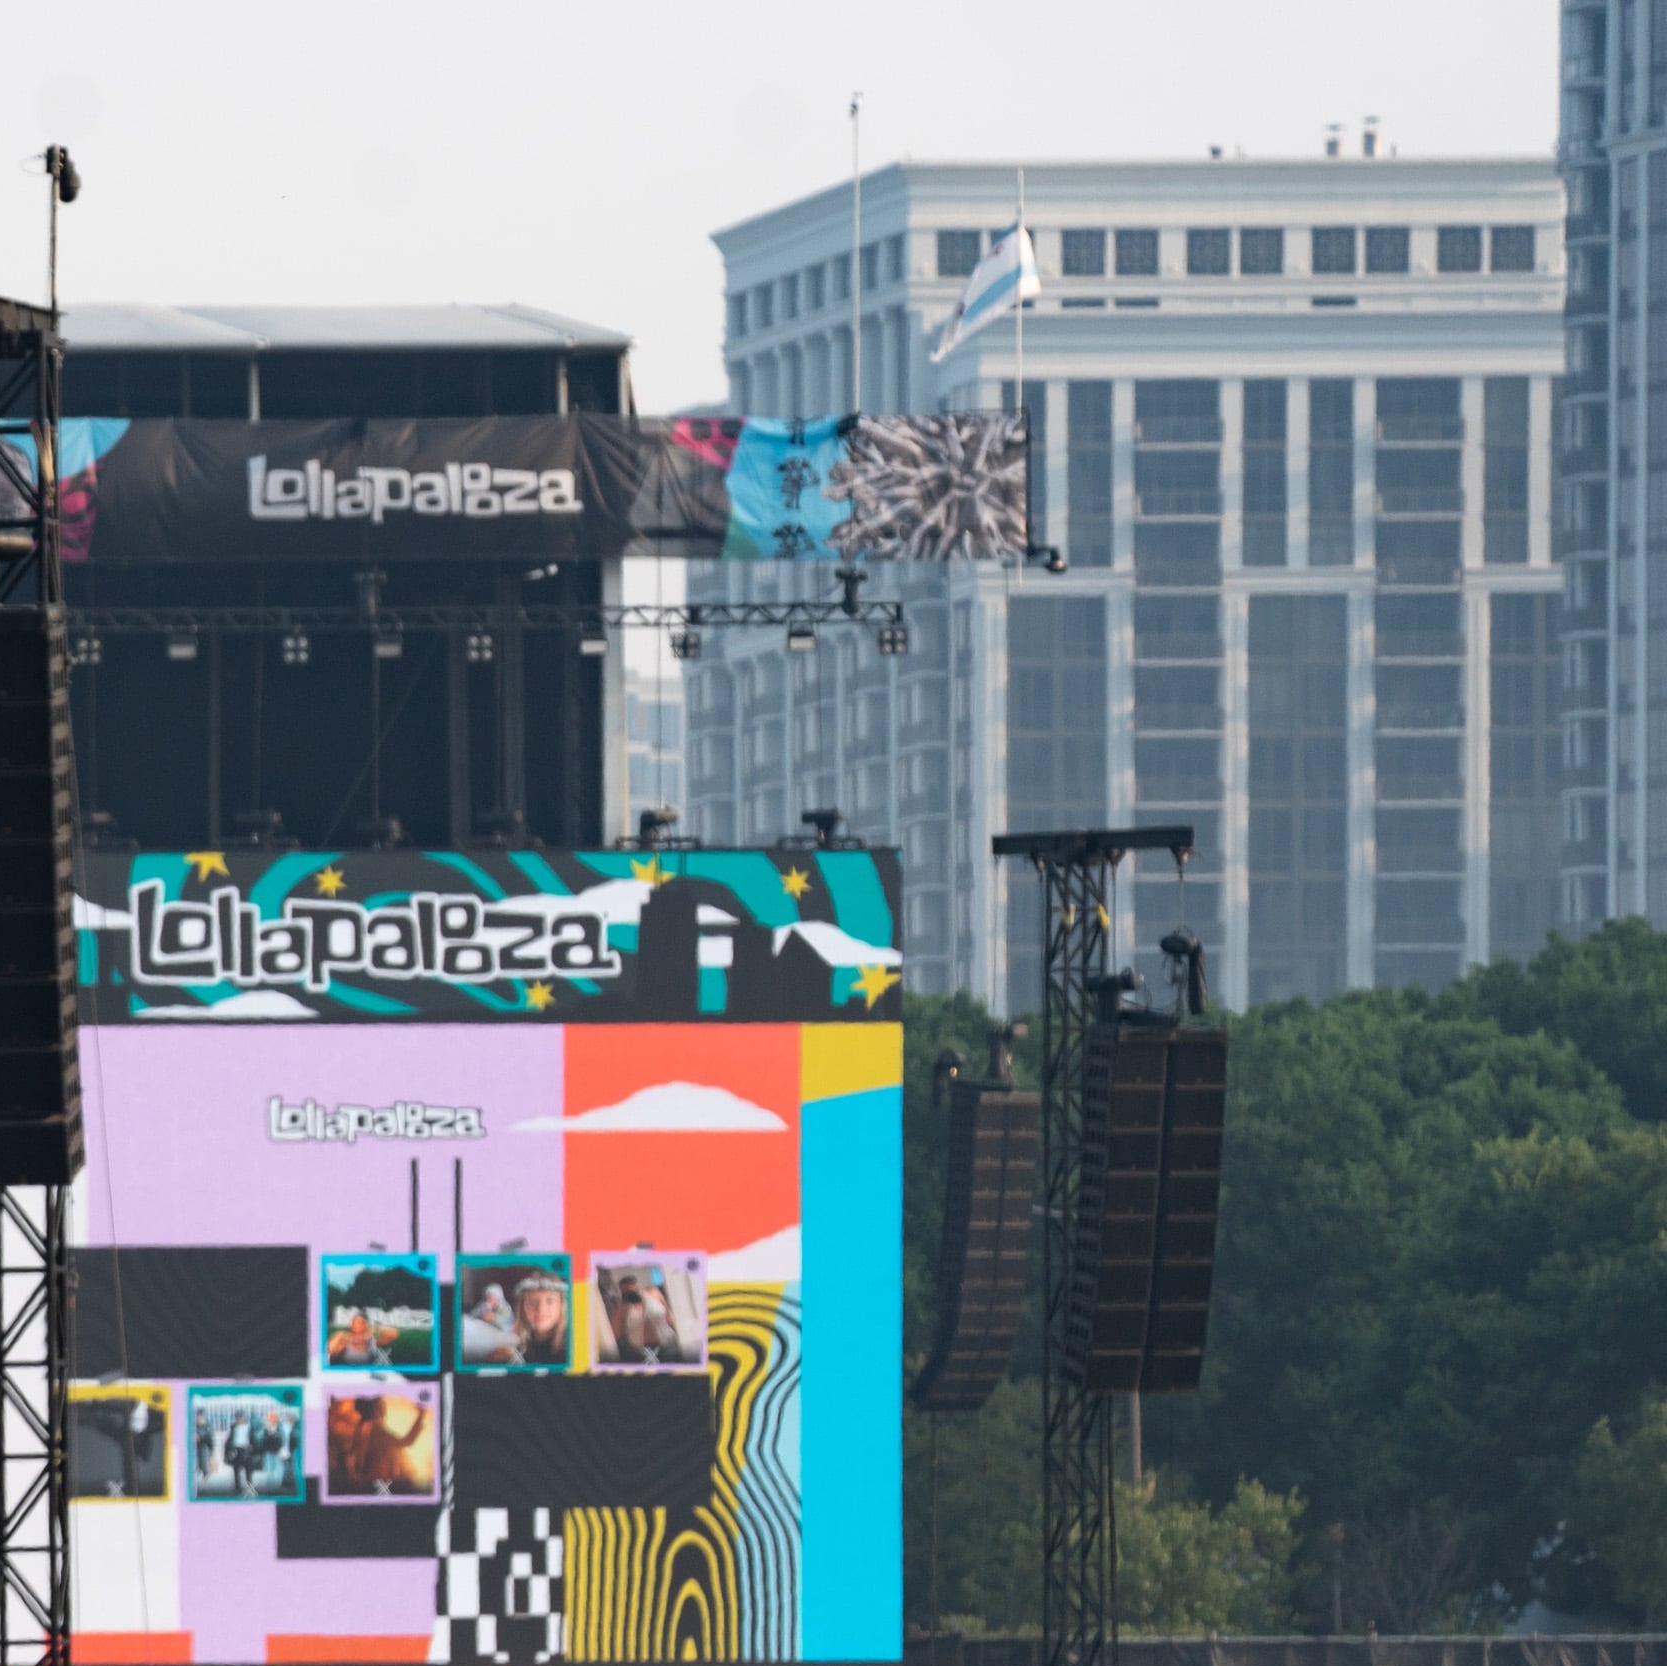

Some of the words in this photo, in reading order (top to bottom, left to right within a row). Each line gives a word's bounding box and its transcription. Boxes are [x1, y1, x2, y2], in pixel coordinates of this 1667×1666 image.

[247, 454, 583, 525] Lollapalooza
[131, 878, 621, 992] Lollapalooza
[268, 1095, 488, 1146] Lollapalooza
